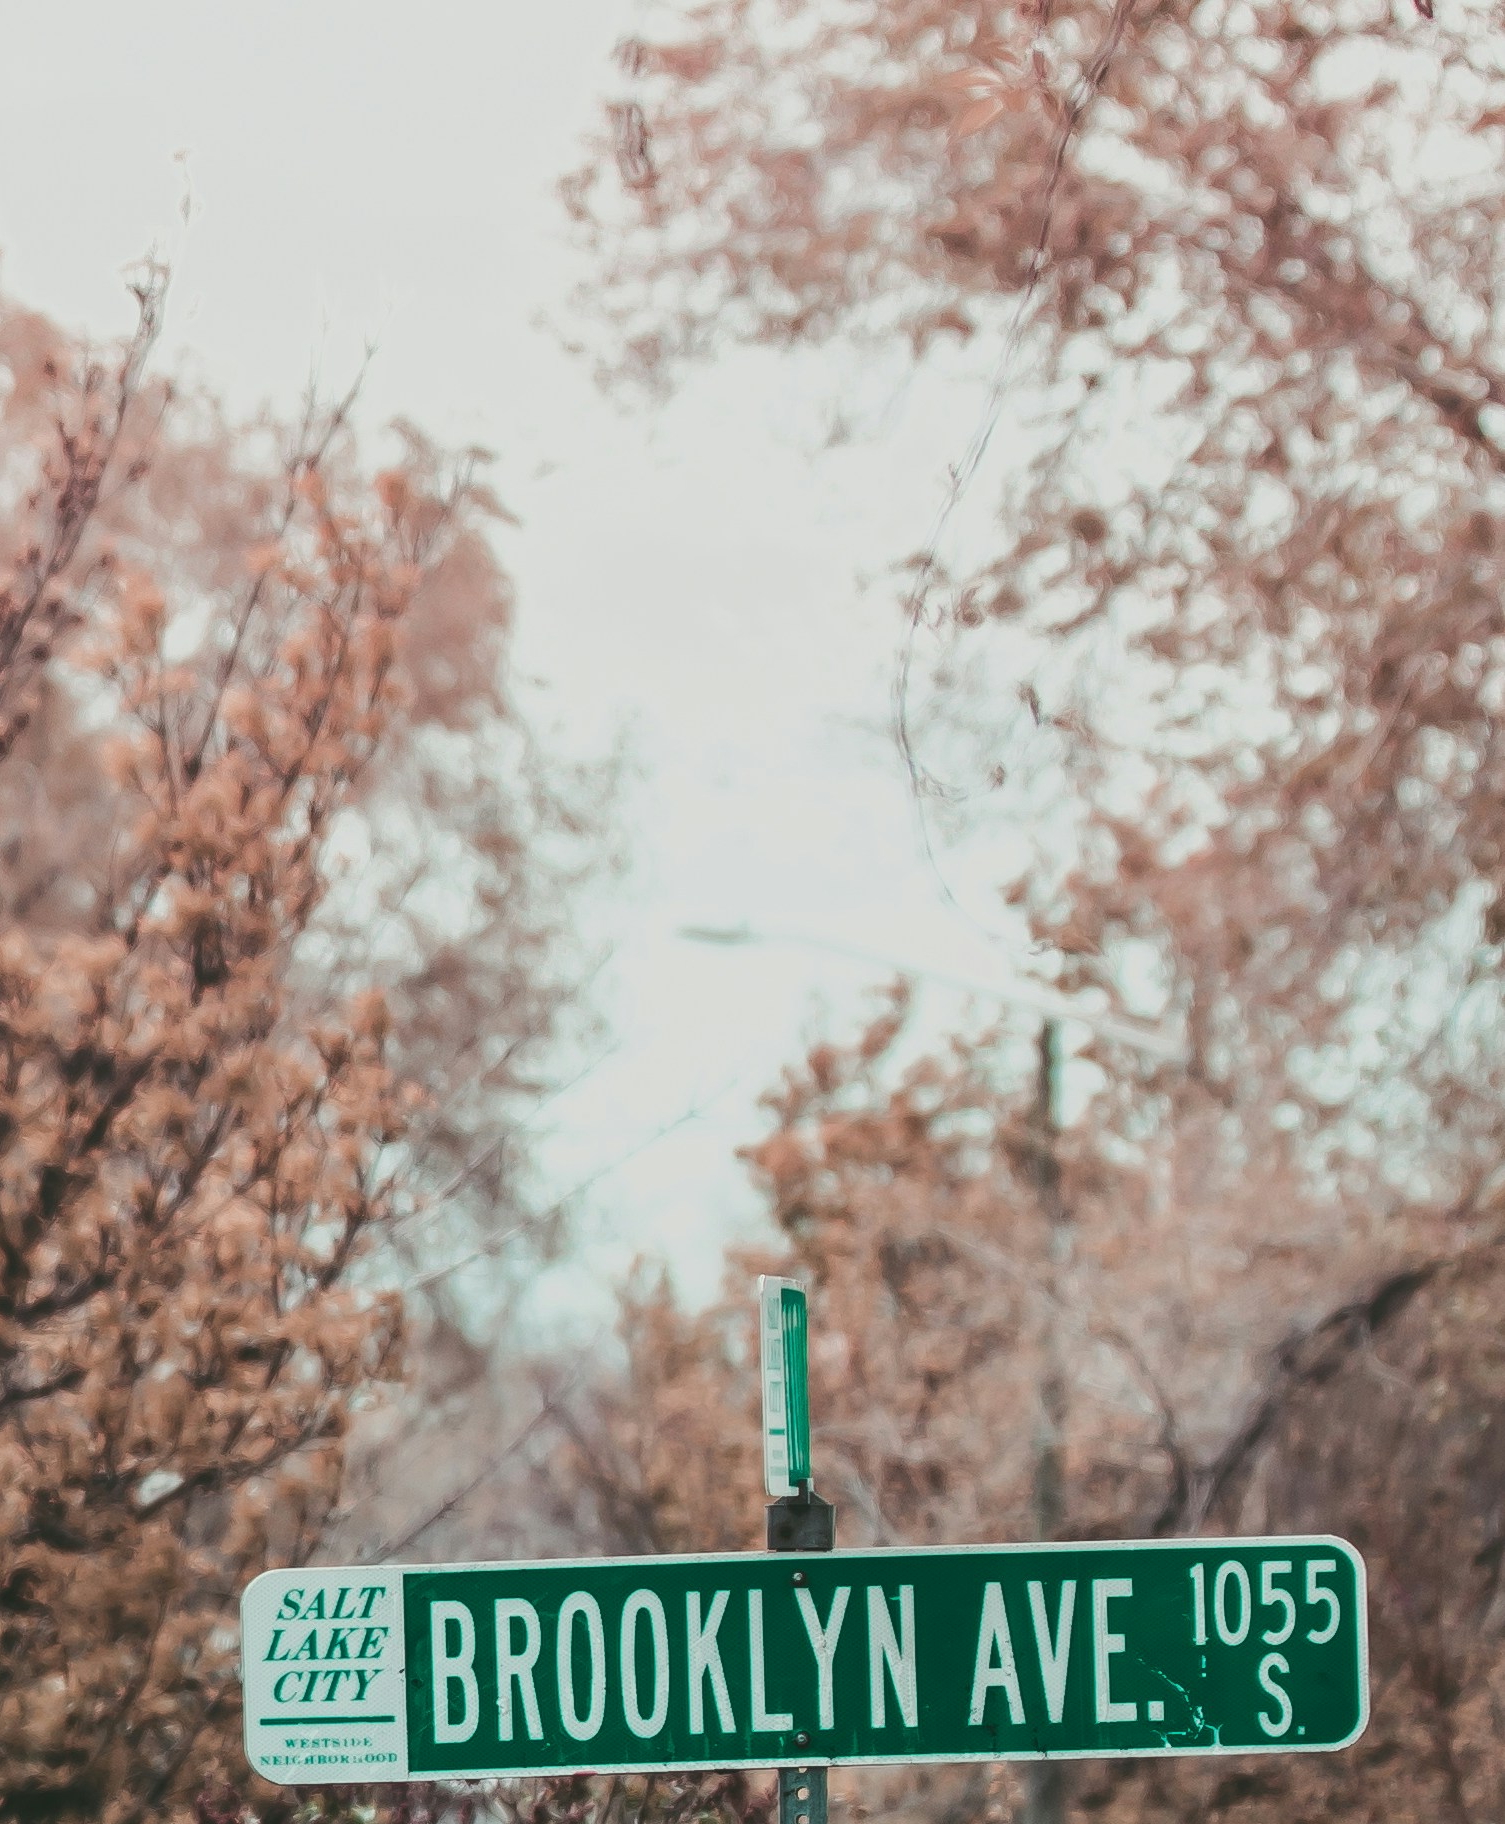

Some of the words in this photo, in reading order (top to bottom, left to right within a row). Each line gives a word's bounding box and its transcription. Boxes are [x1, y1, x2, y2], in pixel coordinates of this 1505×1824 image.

[276, 1586, 386, 1621] SALT
[1190, 1559, 1341, 1646] 1055
[262, 1626, 389, 1662] LAKE
[430, 1587, 919, 1744] BROOKLYN
[968, 1577, 1165, 1726] AVE.
[273, 1668, 383, 1703] CITY
[285, 1737, 373, 1748] WESTSIDE
